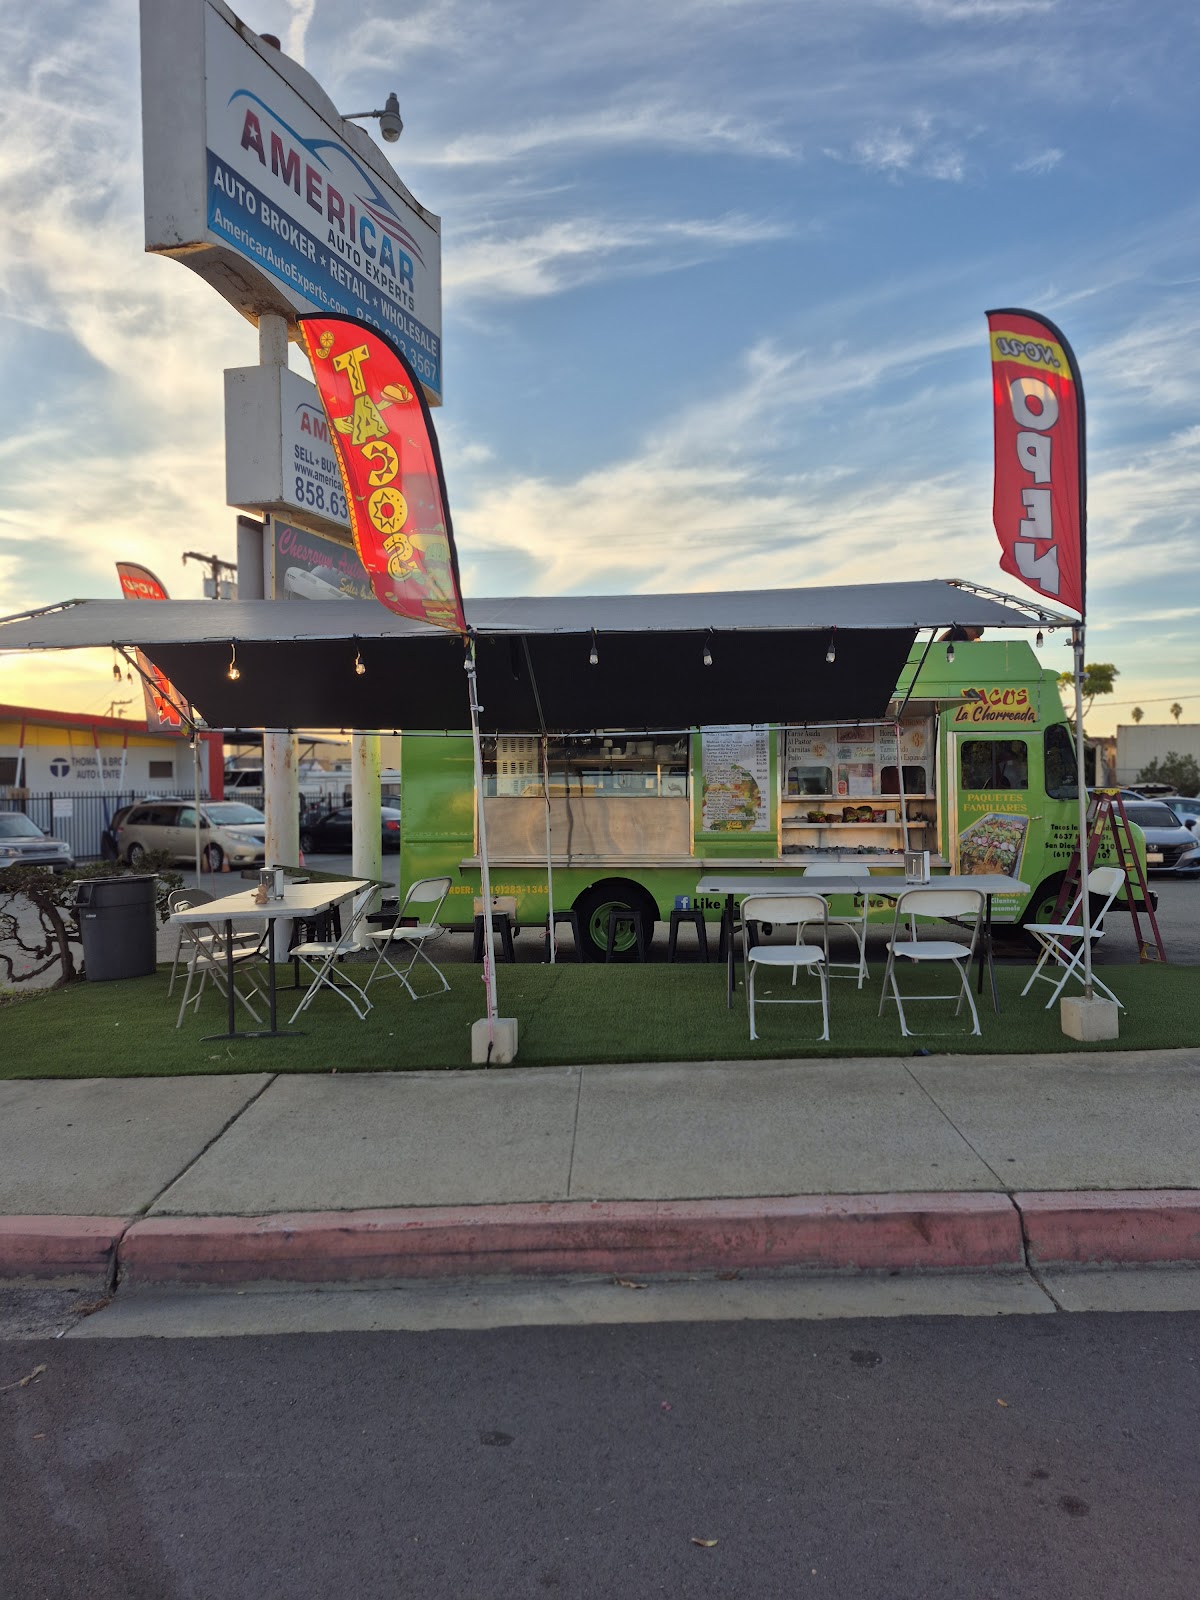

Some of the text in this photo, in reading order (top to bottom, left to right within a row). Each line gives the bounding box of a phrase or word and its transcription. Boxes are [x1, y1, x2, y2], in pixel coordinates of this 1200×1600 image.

[240, 109, 414, 293] AMERICAR
[213, 165, 437, 357] AUTO BROKER RETAIL WHOLESALE
[214, 207, 349, 315] AmericarAutoExperts.com
[327, 228, 415, 312] AUTO EXPERTS
[294, 444, 336, 475] SELL BUY
[955, 705, 1034, 722] La Chorreada
[71, 756, 100, 767] THOMA
[77, 769, 96, 779] AUTO
[967, 794, 1023, 802] PAQUETES
[963, 804, 1028, 812] FAMILIARES
[448, 885, 549, 895] RDER: (19)283-1345
[694, 898, 720, 909] Like
[853, 897, 883, 908] Love
